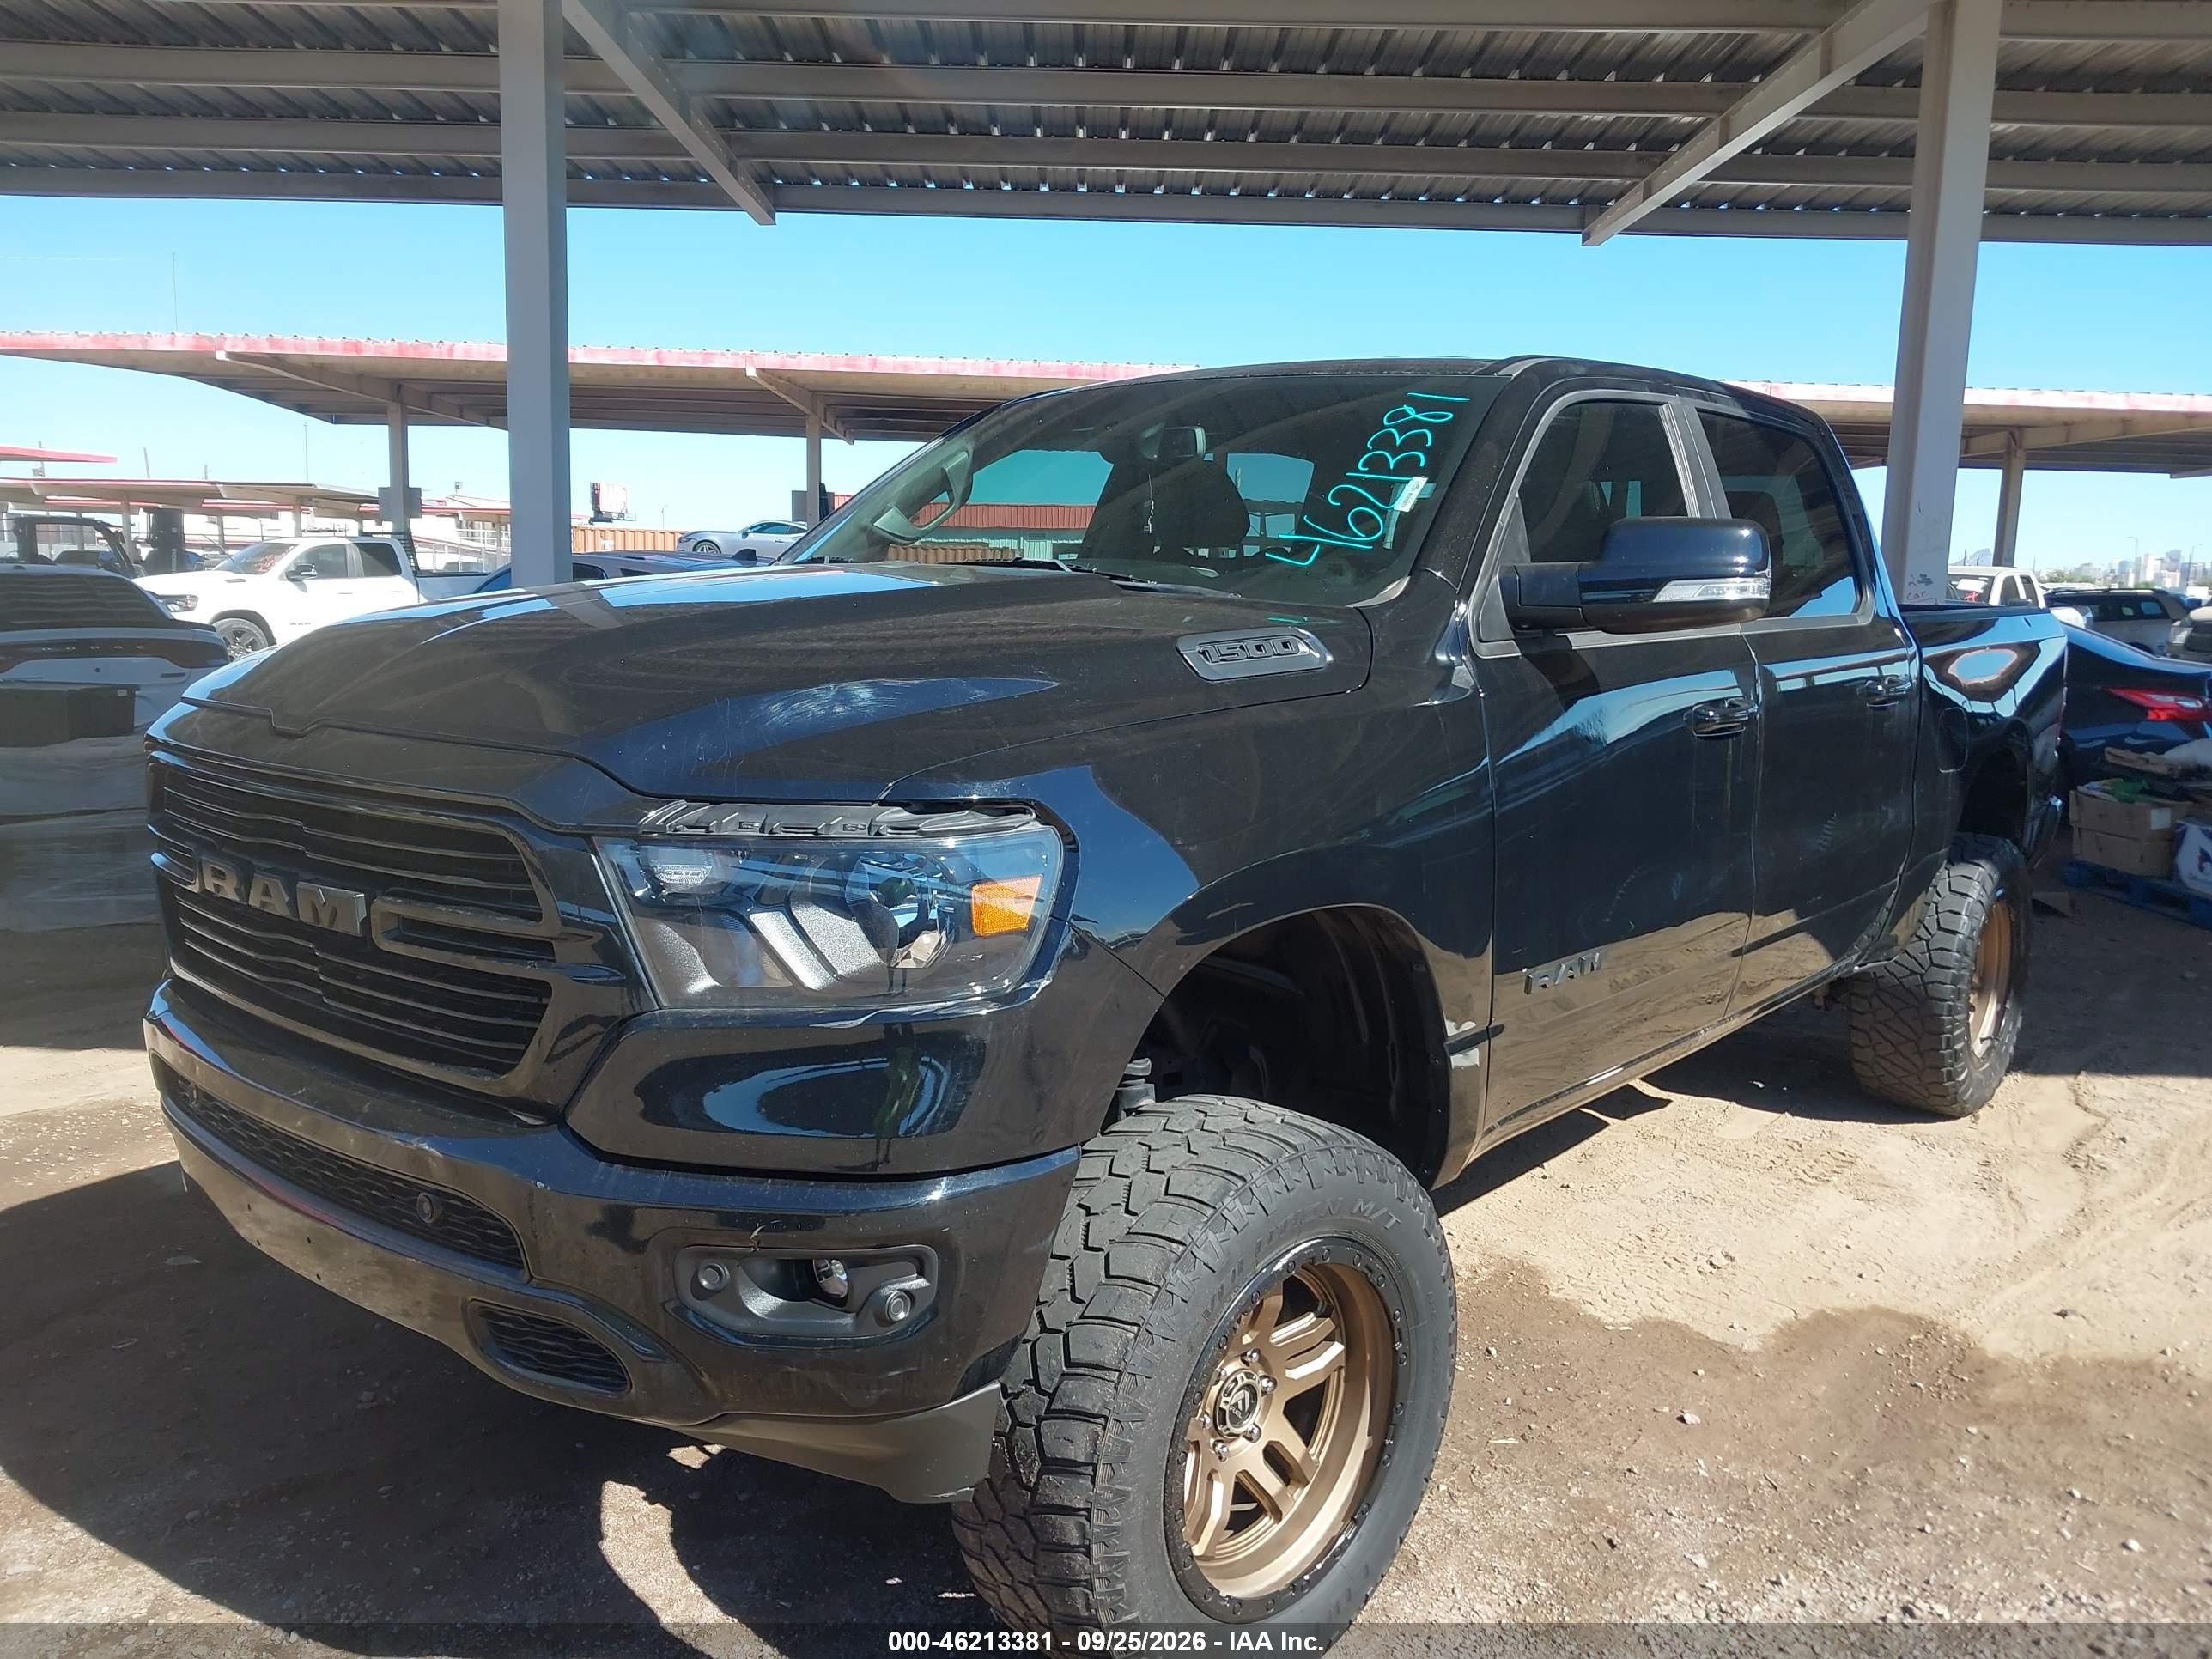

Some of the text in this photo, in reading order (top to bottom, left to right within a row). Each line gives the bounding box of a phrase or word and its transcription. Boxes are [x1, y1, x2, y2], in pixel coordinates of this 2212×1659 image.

[1265, 392, 1471, 566] 46213381
[1198, 638, 1300, 664] 1500
[200, 855, 368, 936] RAM
[1522, 946, 1606, 995] RAM
[1229, 1405, 1243, 1419] FUEL
